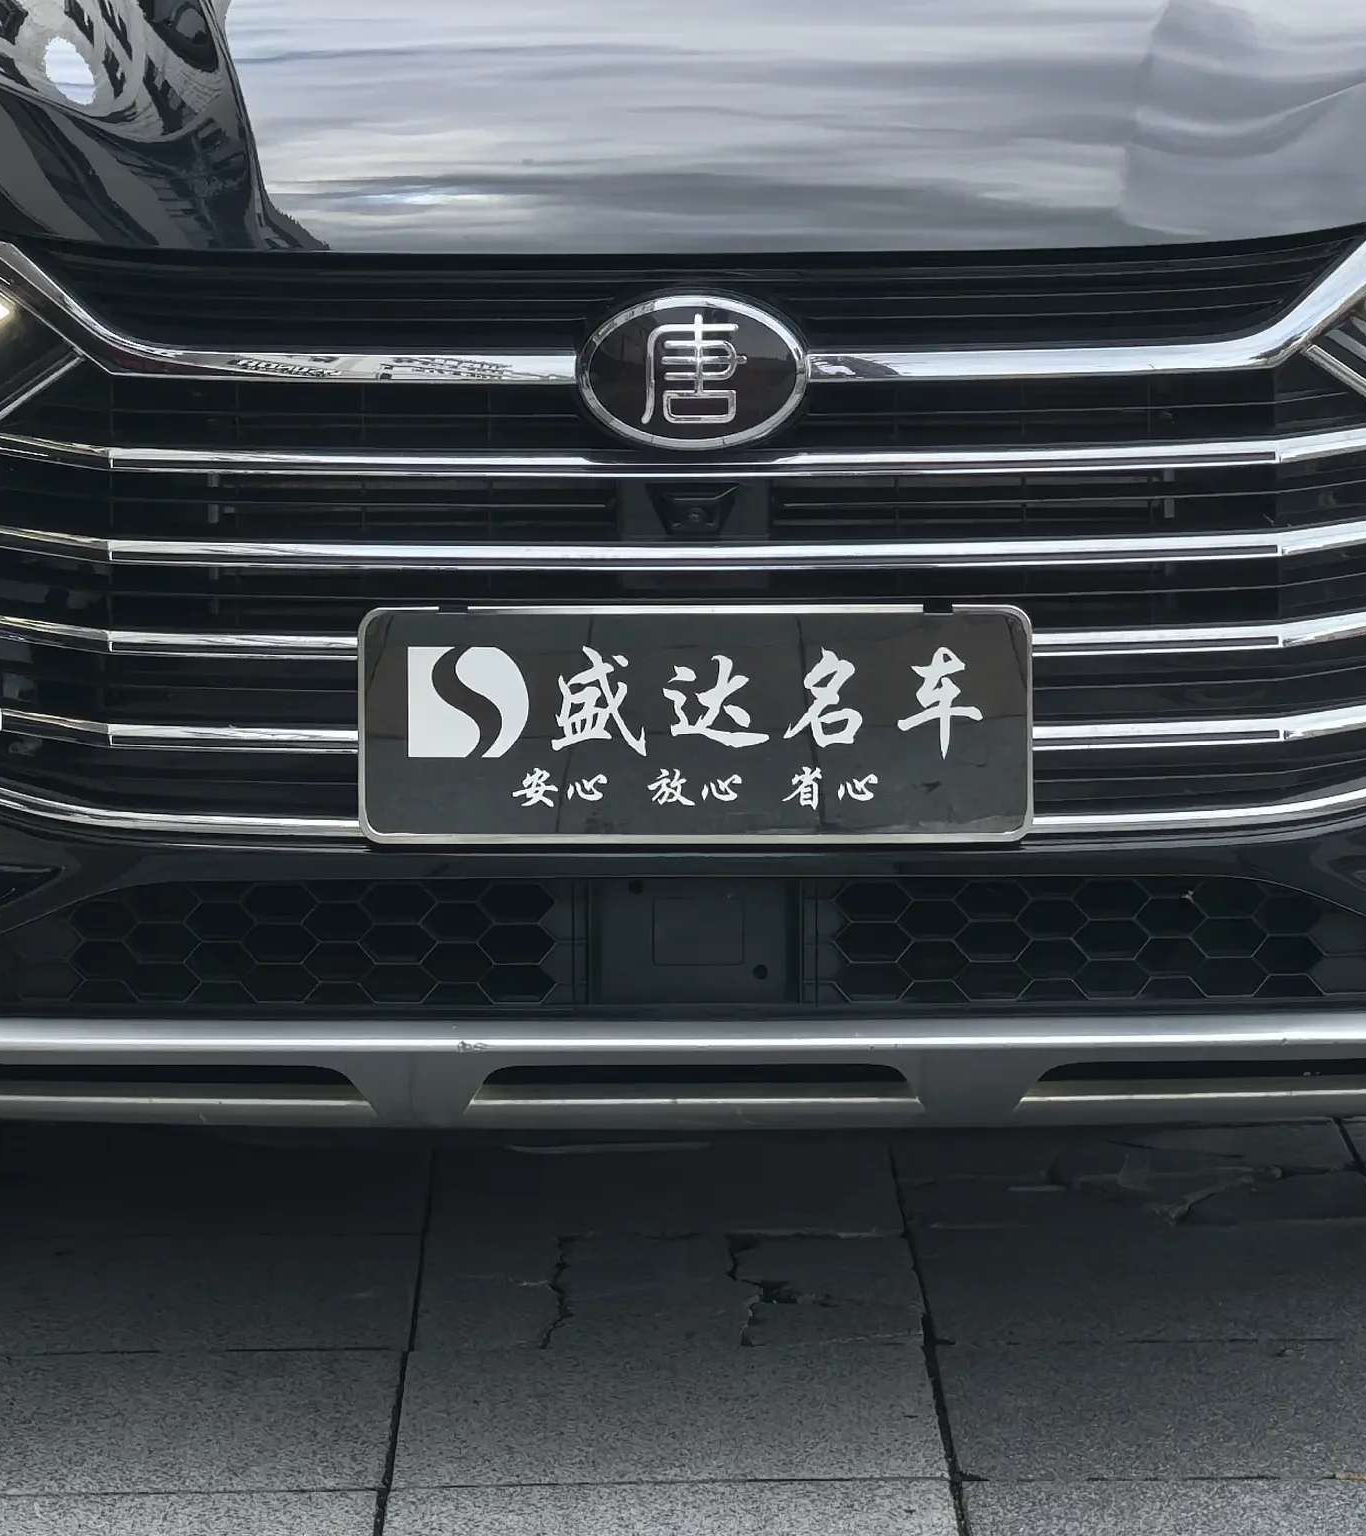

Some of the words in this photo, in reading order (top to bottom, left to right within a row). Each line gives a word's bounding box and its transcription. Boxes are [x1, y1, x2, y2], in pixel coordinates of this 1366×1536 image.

[641, 314, 748, 424] 唐
[552, 646, 983, 760] 盛达名车
[512, 767, 608, 806] 安心
[647, 769, 742, 806] 放心
[781, 768, 878, 807] 省心
